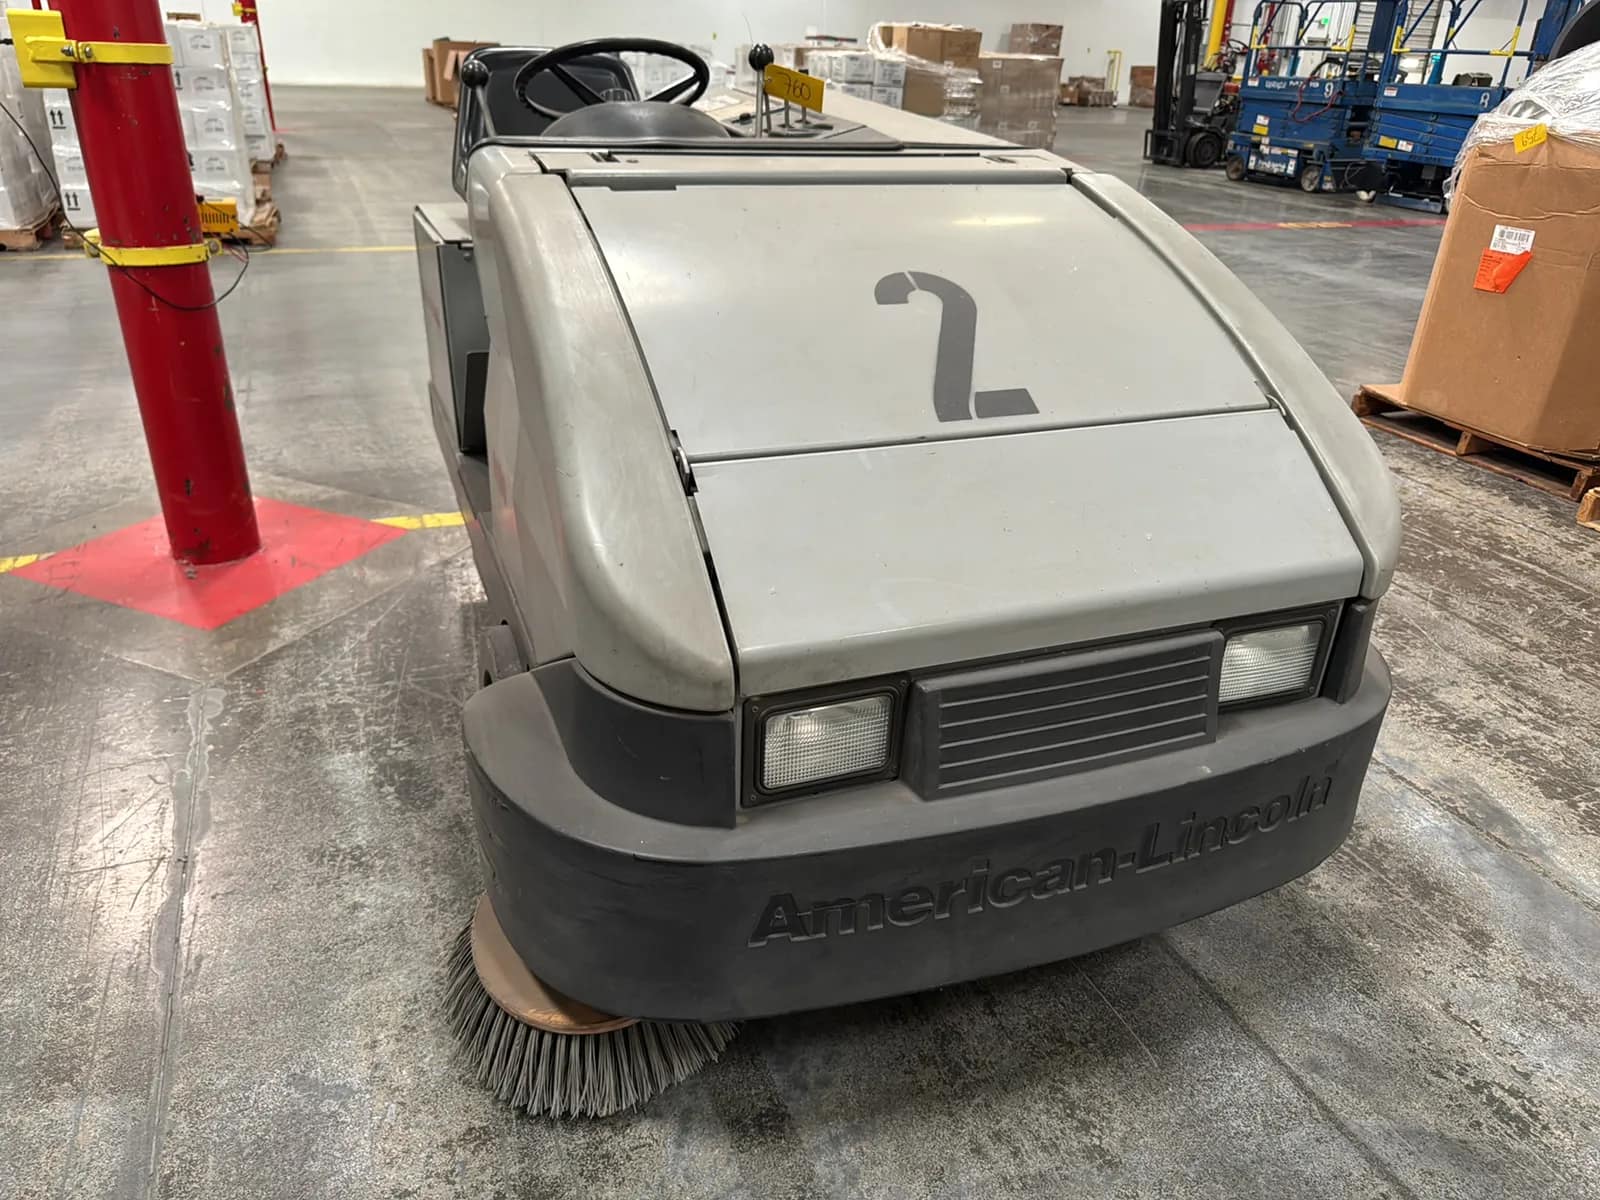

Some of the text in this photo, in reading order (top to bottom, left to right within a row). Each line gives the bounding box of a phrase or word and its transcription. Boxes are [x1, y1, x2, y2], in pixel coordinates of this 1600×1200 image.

[775, 71, 812, 101] 760
[1324, 82, 1334, 98] 9
[874, 270, 1040, 422] 2
[747, 775, 1333, 947] American-Lincoln
